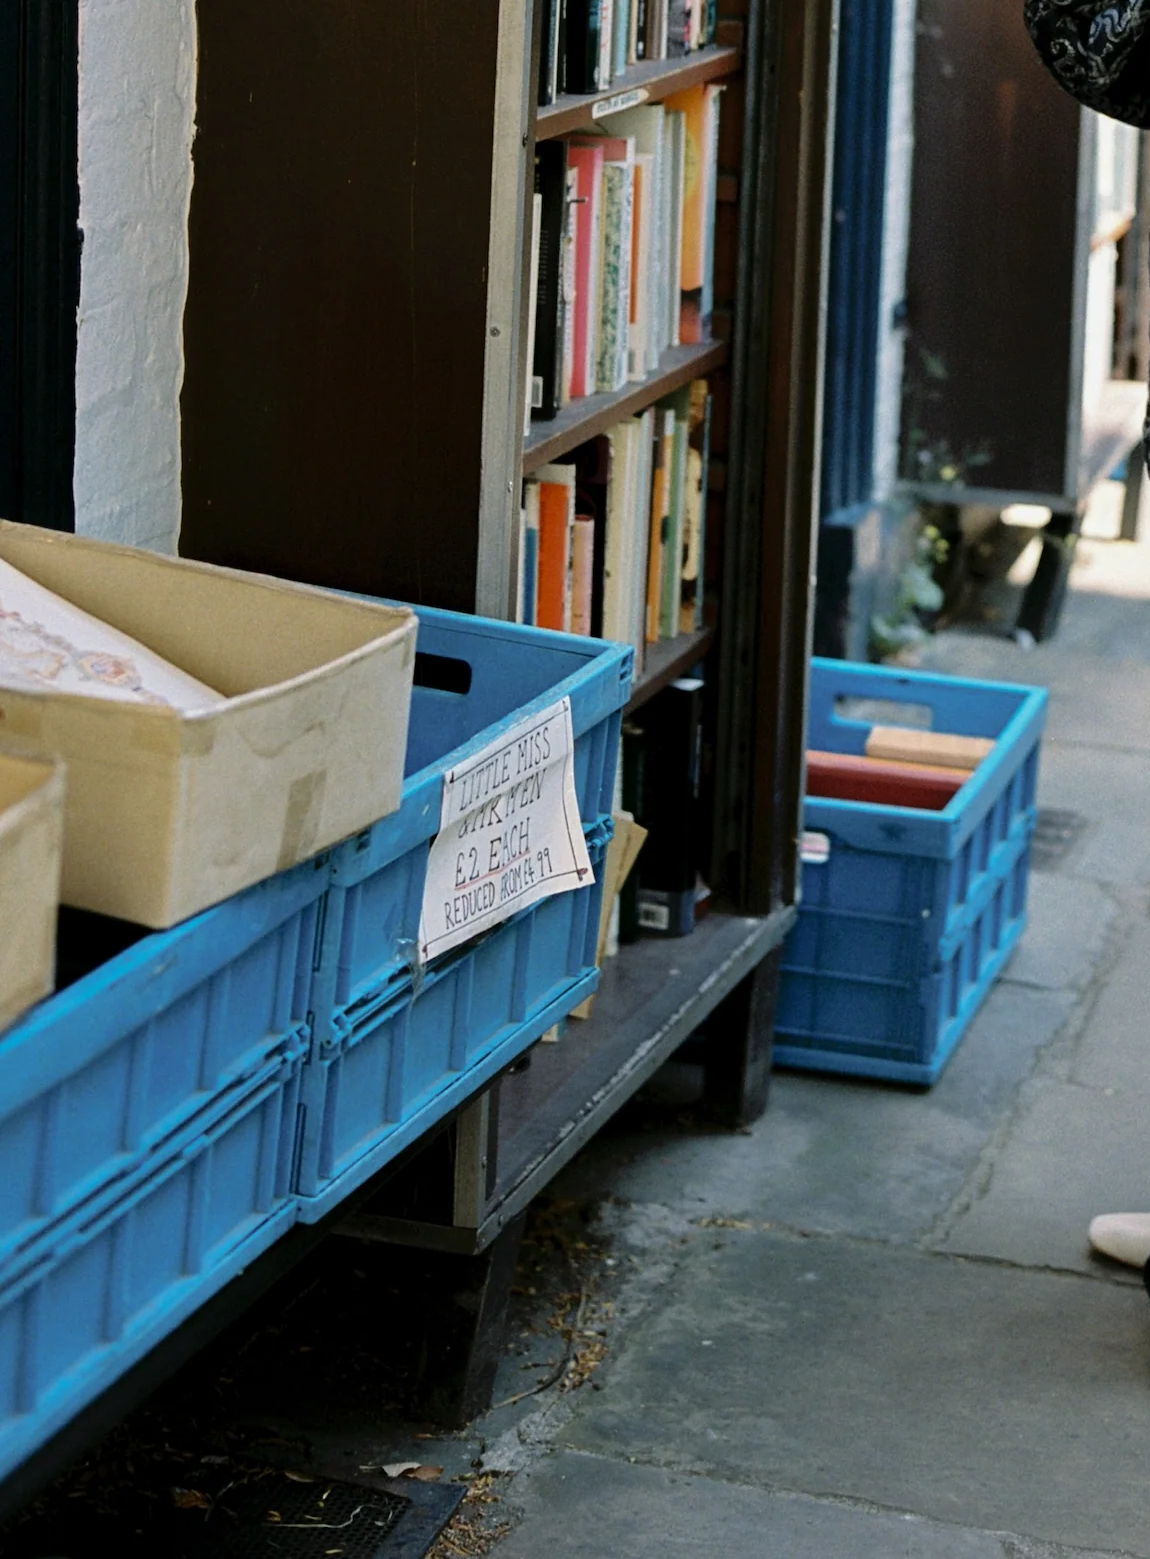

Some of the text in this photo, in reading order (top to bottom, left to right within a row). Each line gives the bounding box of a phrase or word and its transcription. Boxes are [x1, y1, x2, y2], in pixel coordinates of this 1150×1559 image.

[459, 727, 551, 812] LITTLE MISS
[505, 767, 548, 818] MEN
[489, 816, 530, 872] EACH
[444, 881, 496, 930] REDUCED
[500, 864, 523, 902] FROM
